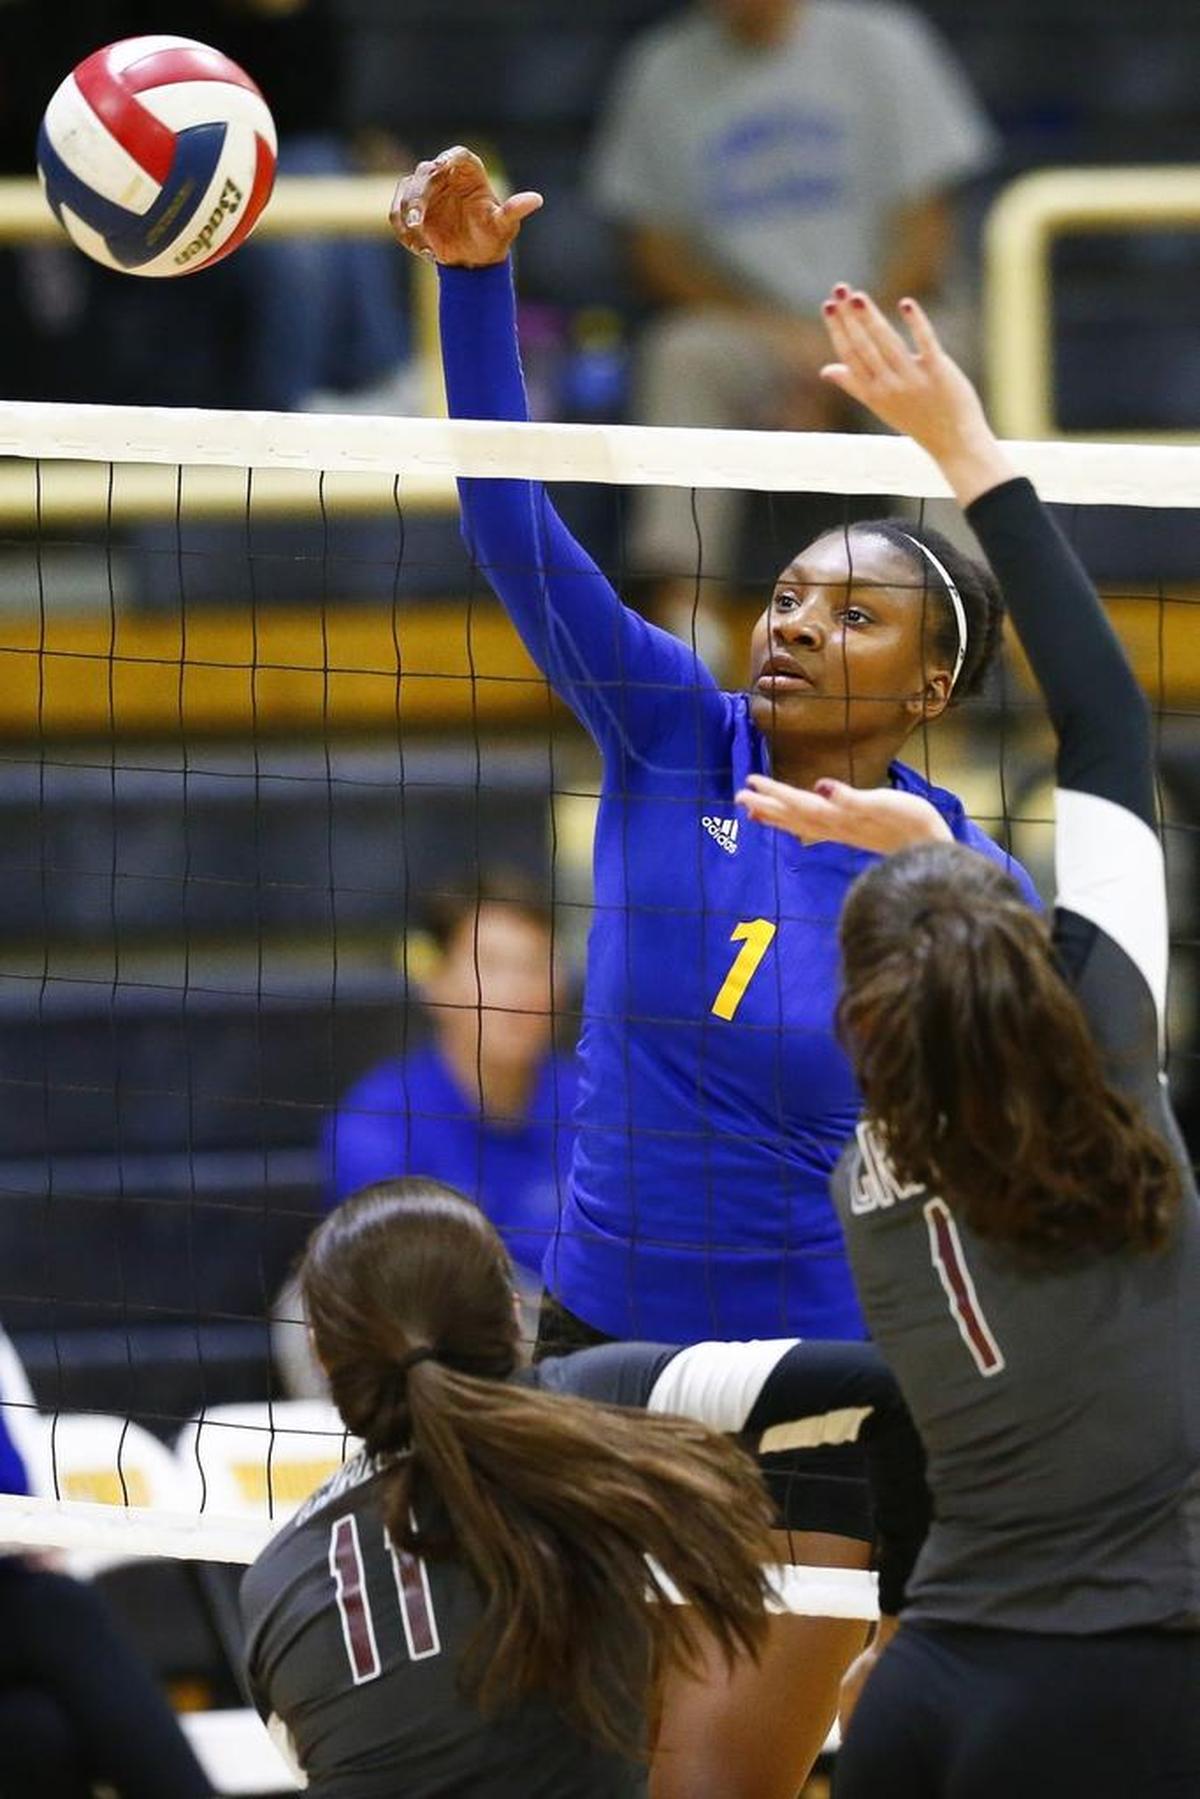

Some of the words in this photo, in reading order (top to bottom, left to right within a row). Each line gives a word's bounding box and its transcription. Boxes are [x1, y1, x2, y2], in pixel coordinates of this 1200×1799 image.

[174, 177, 242, 265] Baden
[701, 816, 738, 854] adidas
[710, 917, 777, 1021] 1
[923, 1196, 1006, 1378] 1
[328, 1512, 441, 1686] 11
